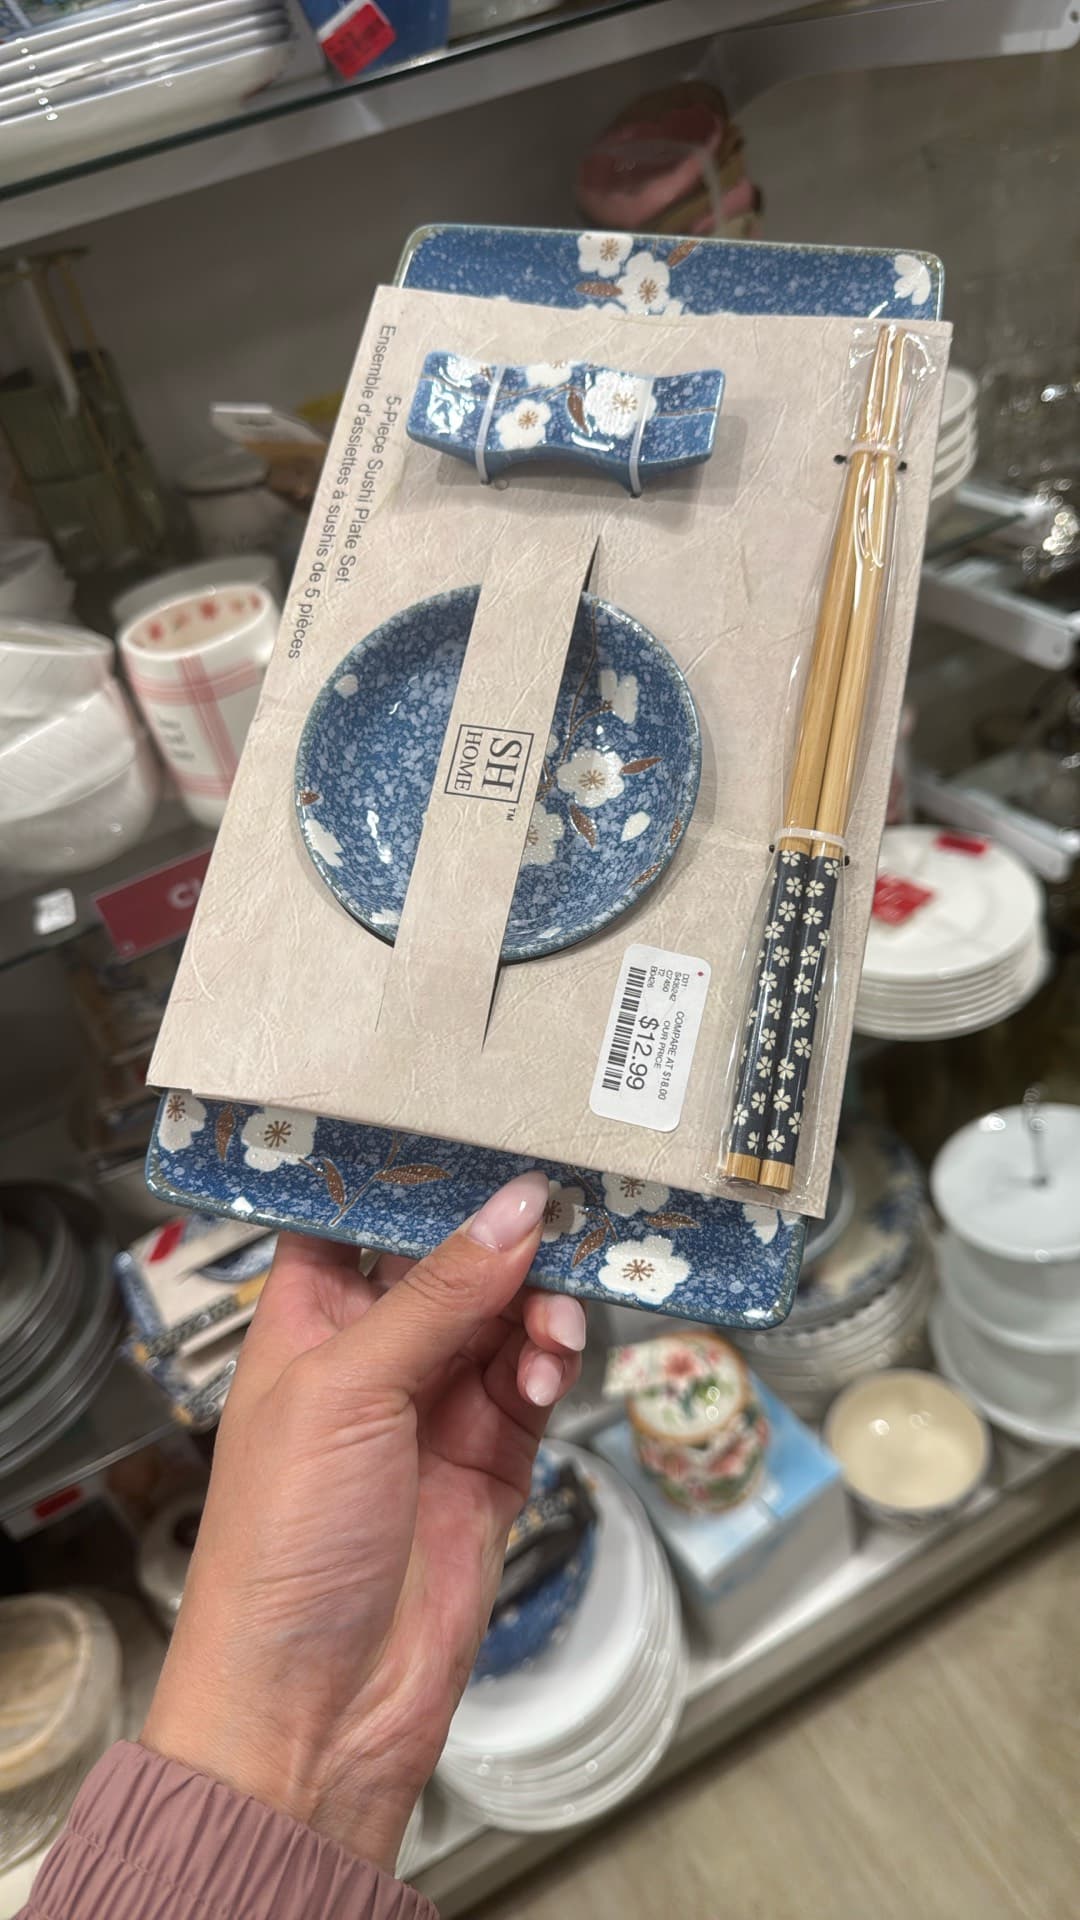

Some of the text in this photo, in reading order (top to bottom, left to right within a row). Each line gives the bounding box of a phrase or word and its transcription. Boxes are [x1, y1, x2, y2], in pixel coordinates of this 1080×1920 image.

[288, 324, 397, 660] Ensemble d'assiettes à sushis de 5 pièces
[335, 395, 402, 584] 5-Piece Sushi Plate Set
[454, 730, 483, 792] HOME
[482, 737, 523, 793] SH
[626, 1015, 660, 1090] $12.99
[653, 1020, 671, 1069] OUR PRICE
[657, 1010, 685, 1101] COMPARE AT $18.00
